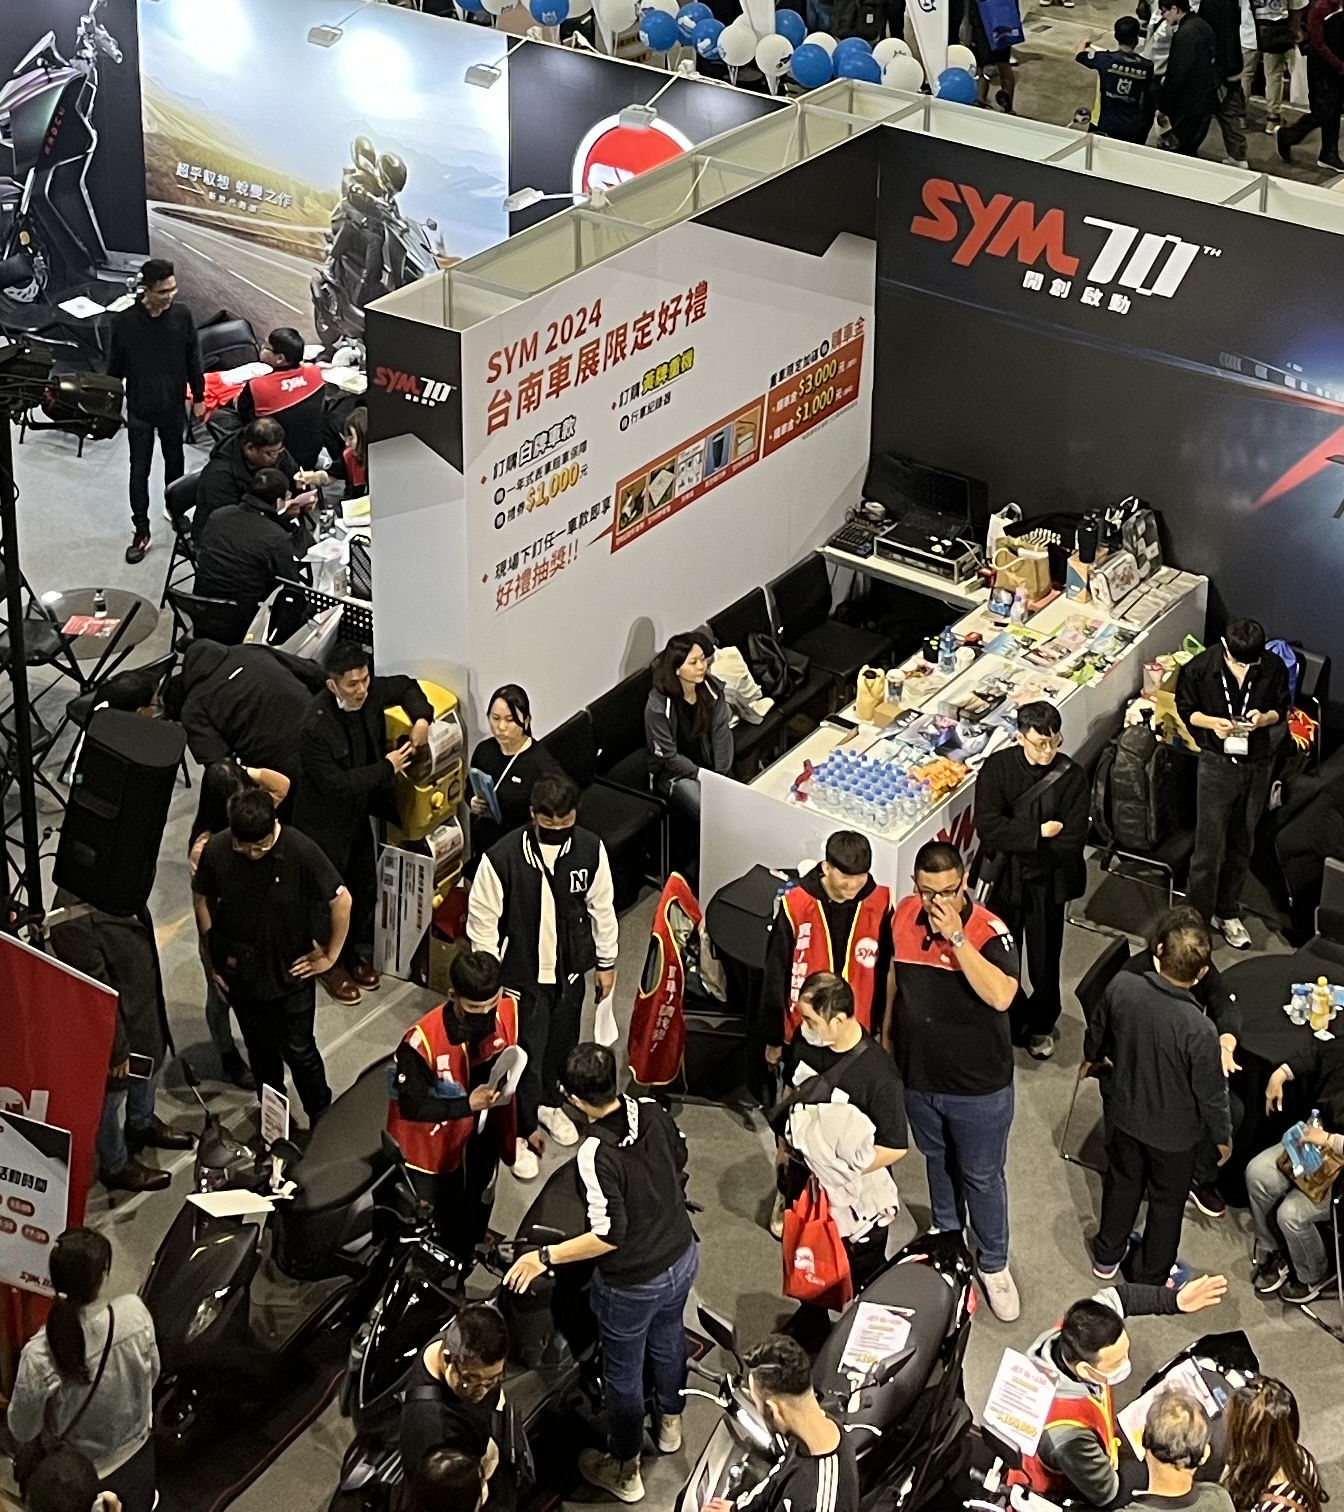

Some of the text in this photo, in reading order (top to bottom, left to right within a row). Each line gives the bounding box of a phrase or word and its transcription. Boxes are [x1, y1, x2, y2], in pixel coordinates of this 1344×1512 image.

[909, 176, 1081, 279] SYM
[1022, 268, 1132, 316] 開創啟動
[486, 297, 603, 385] SYM 2024
[486, 279, 709, 437] 台南車展限定好禮
[280, 375, 308, 393] SYM
[373, 366, 420, 395] SYM
[569, 868, 590, 893] N
